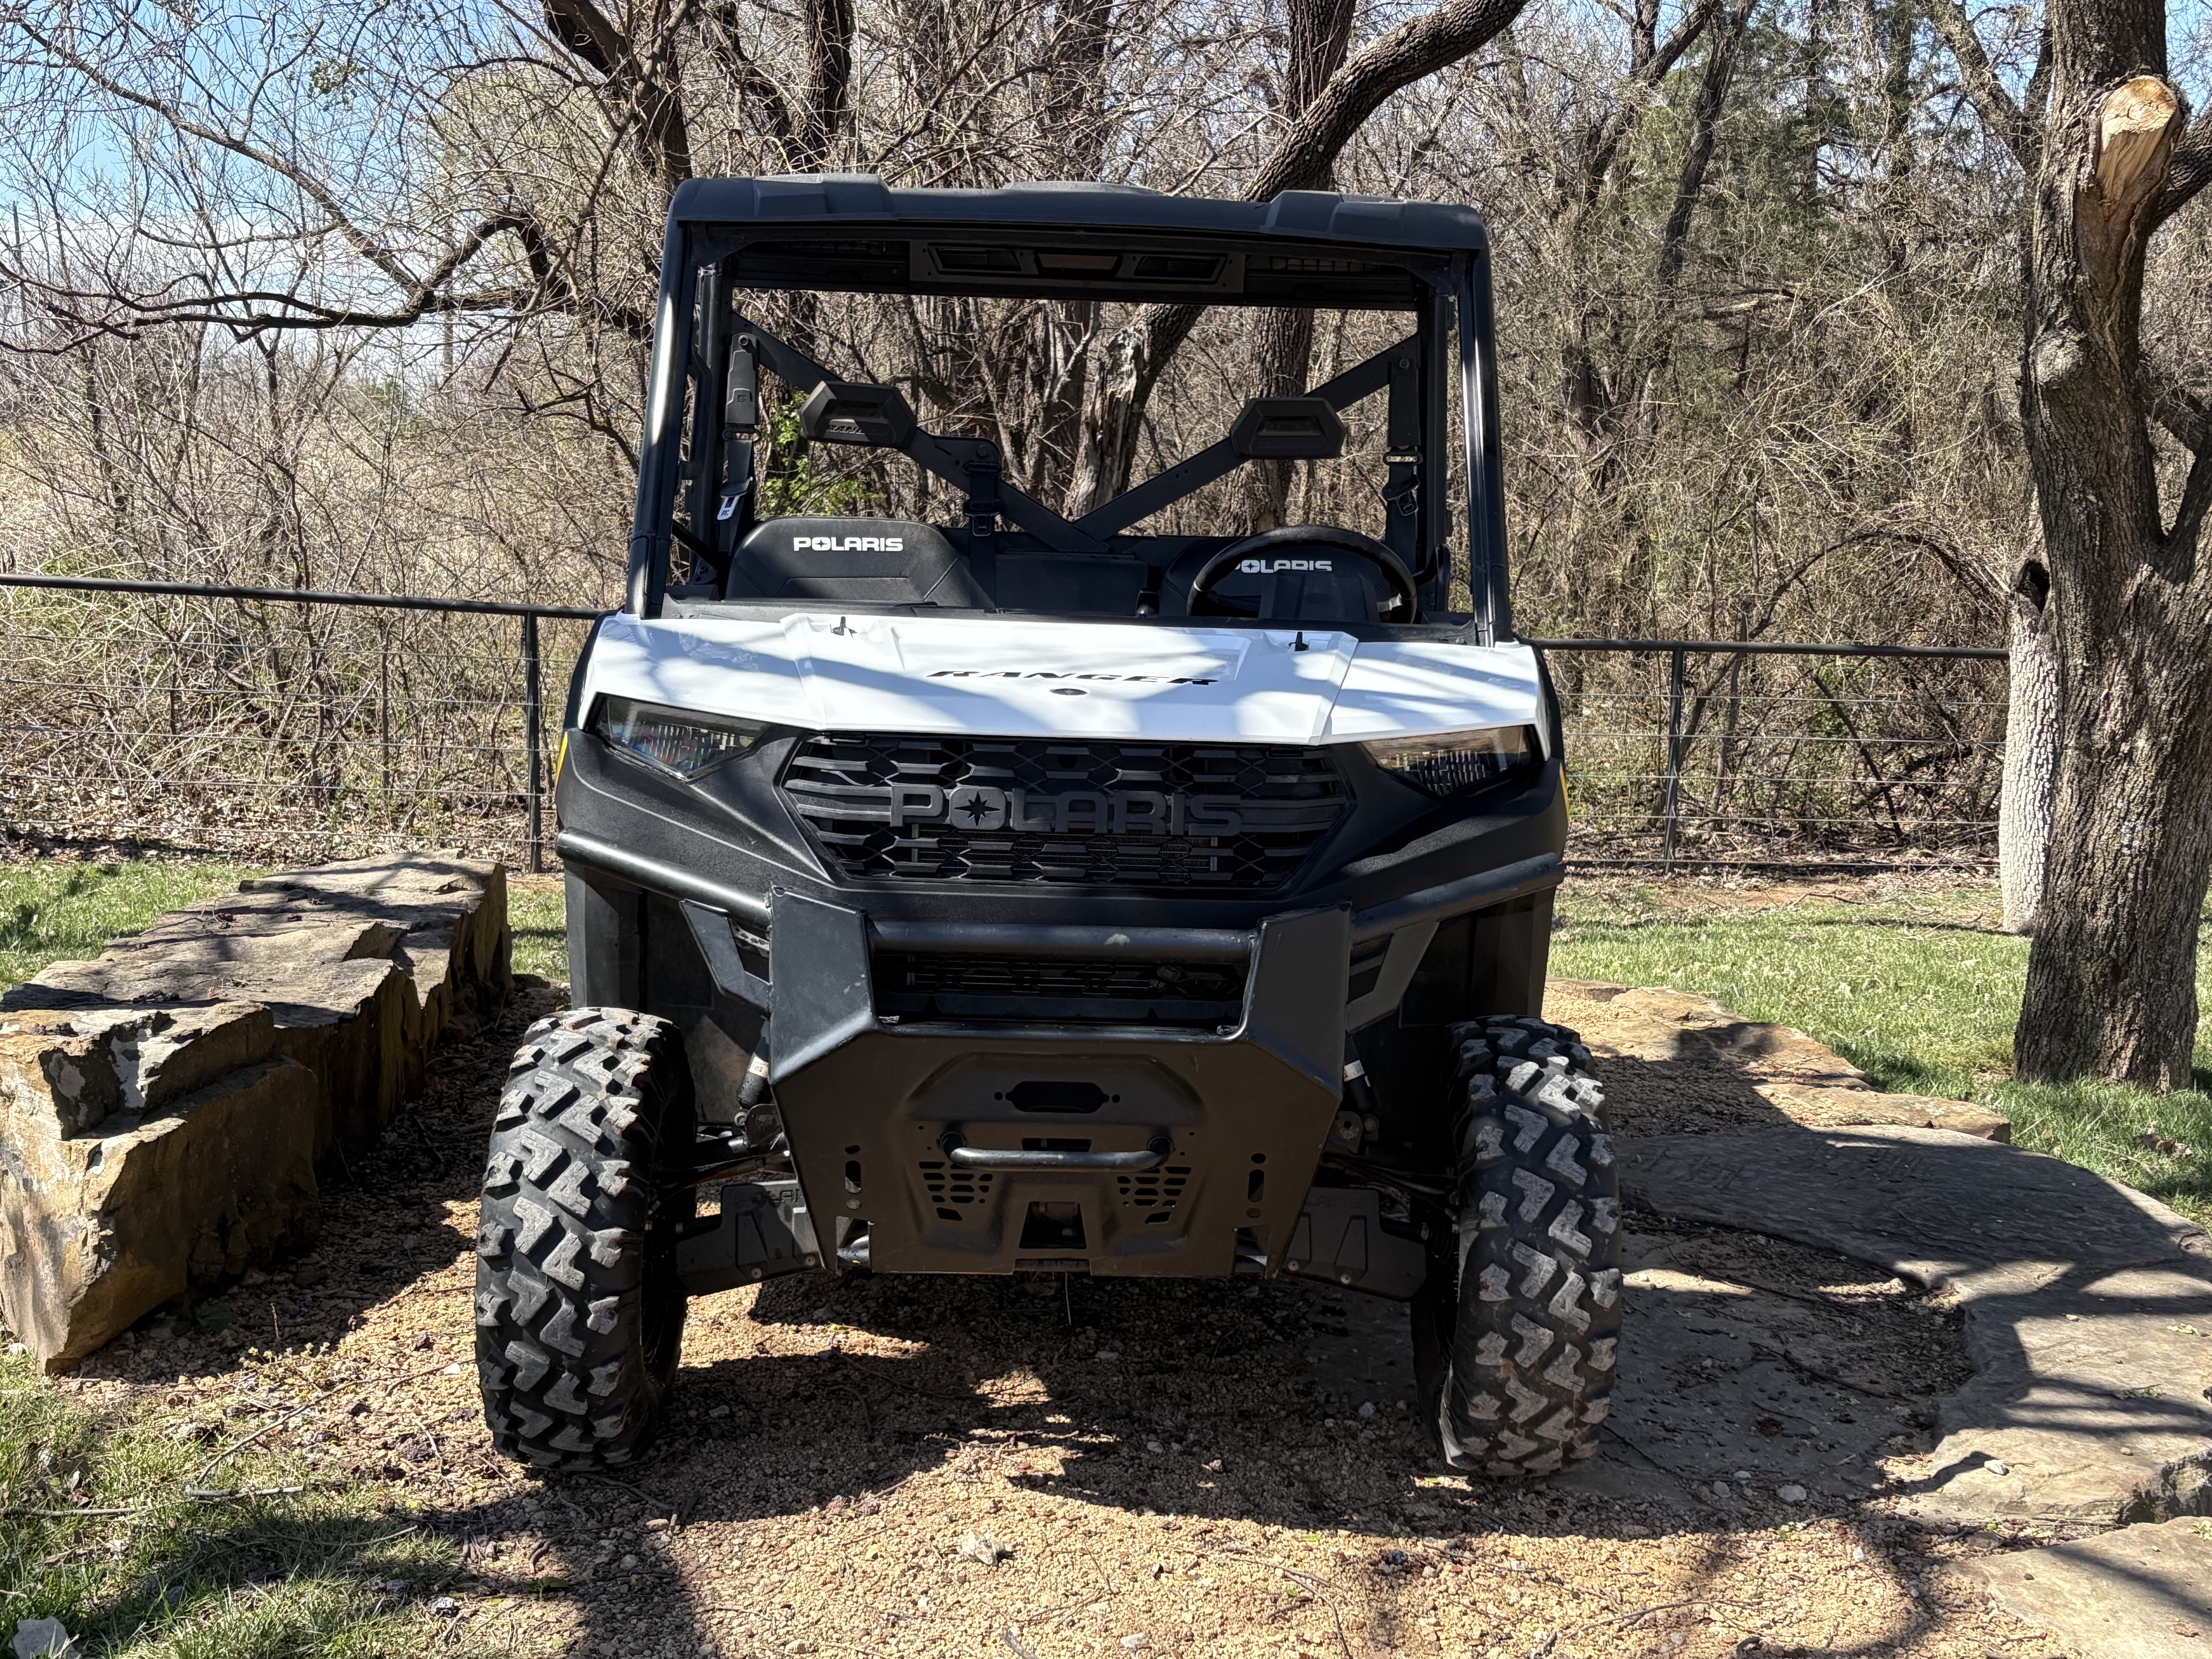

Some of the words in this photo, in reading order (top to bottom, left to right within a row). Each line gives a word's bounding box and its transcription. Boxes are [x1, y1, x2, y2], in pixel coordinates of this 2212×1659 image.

[793, 537, 903, 551] POLARIS
[1235, 560, 1332, 573] OLARIS
[926, 671, 1219, 685] RANGER
[890, 783, 1242, 836] POLARIS
